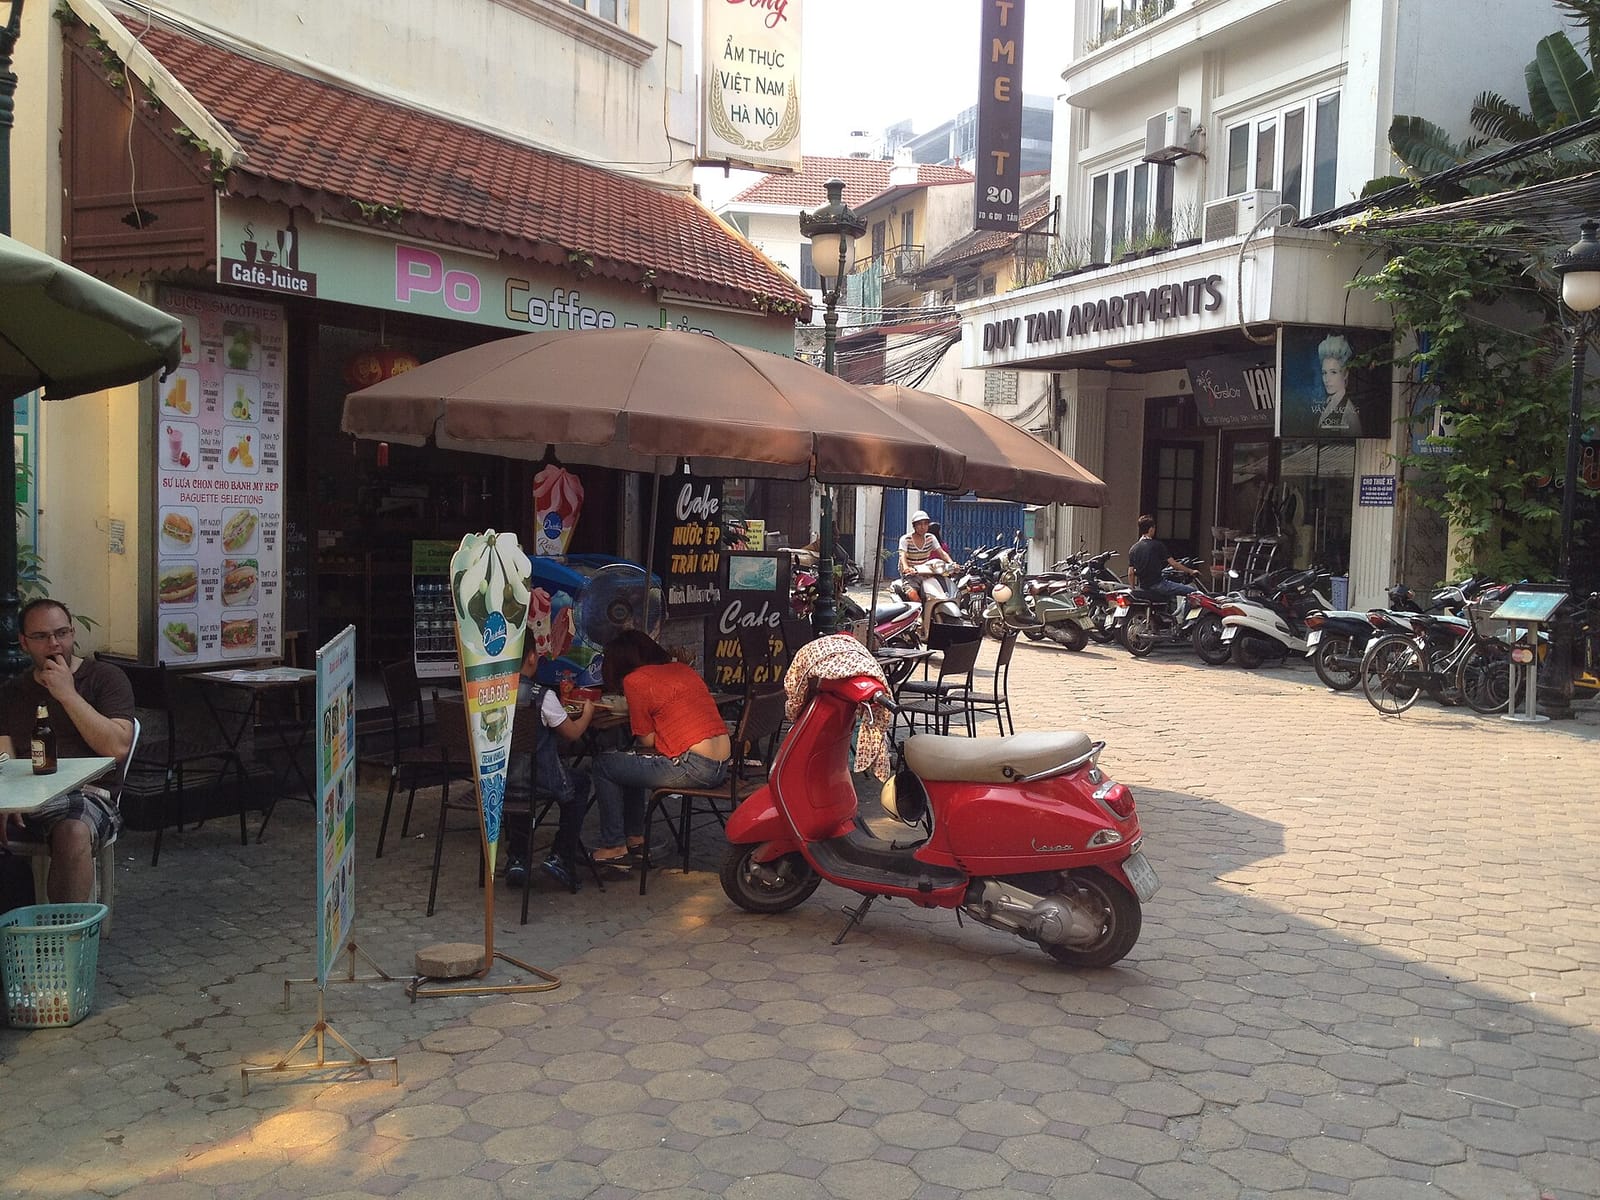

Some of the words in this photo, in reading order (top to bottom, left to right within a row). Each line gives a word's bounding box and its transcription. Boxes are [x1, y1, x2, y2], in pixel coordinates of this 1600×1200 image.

[749, 48, 784, 70] THỰC
[755, 76, 784, 96] NAM
[991, 0, 1016, 176] TMET
[730, 104, 750, 124] HÀ
[755, 107, 778, 128] NỘI
[986, 186, 1013, 204] 20
[231, 263, 308, 291] Café-Juice
[395, 243, 481, 313] Po
[505, 277, 615, 330] Coffee
[983, 317, 1020, 351] DUY
[1025, 309, 1062, 344] TAN
[1066, 274, 1222, 337] APARTMENTS
[180, 493, 219, 503] BAGUETTE
[221, 494, 264, 505] SELECTIONS
[675, 483, 719, 520] Cafe
